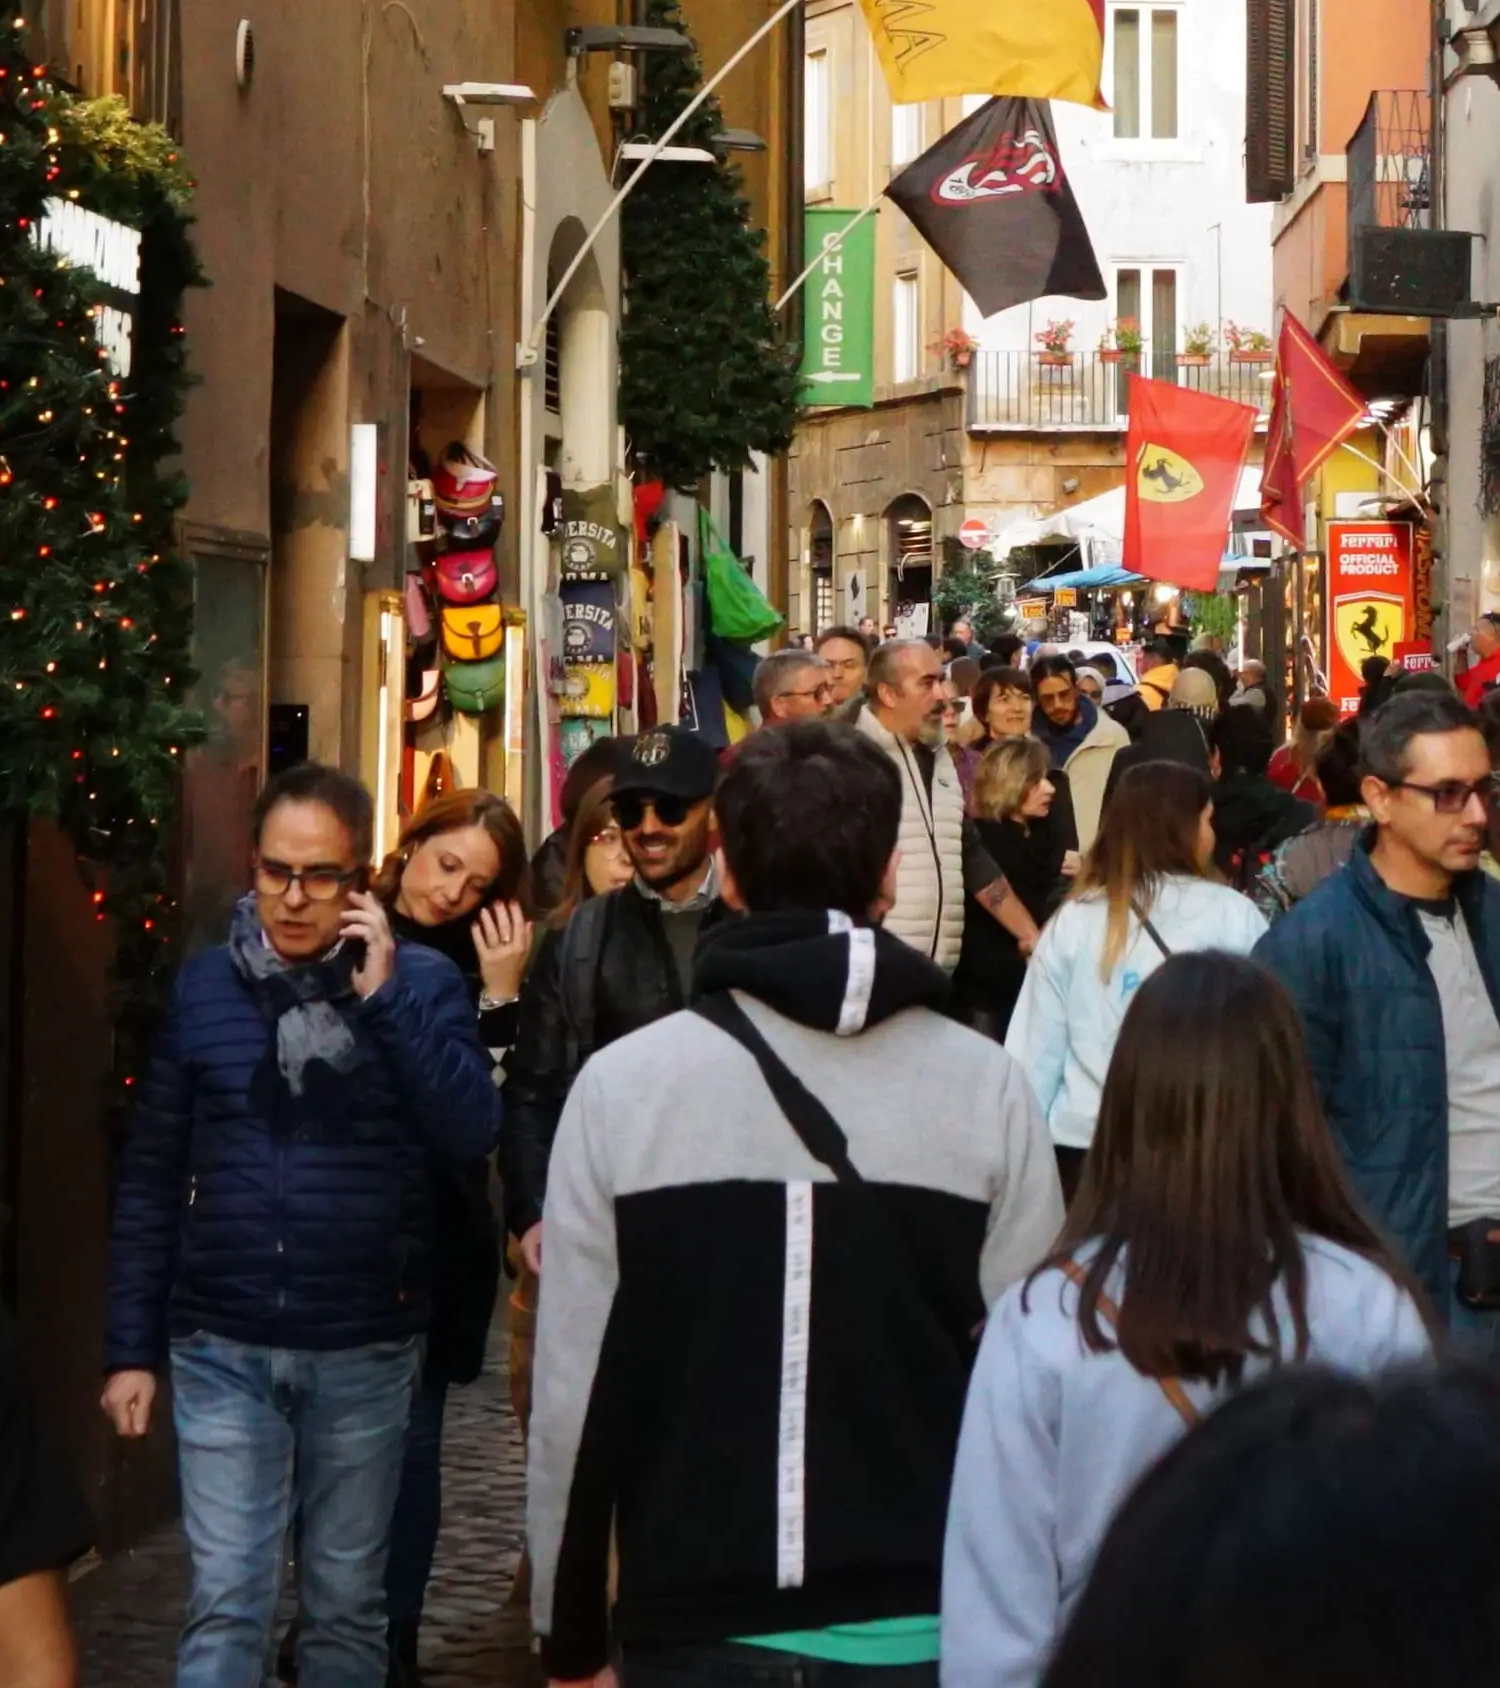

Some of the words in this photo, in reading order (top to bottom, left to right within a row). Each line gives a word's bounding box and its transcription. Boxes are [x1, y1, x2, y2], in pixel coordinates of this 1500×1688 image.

[820, 231, 844, 367] CHANGE
[564, 520, 617, 550] ERSITA
[1339, 533, 1398, 549] Ferrari
[1339, 553, 1395, 565] OFFICIAL
[1339, 564, 1399, 576] PRODUCT
[564, 603, 615, 631] ERSITA
